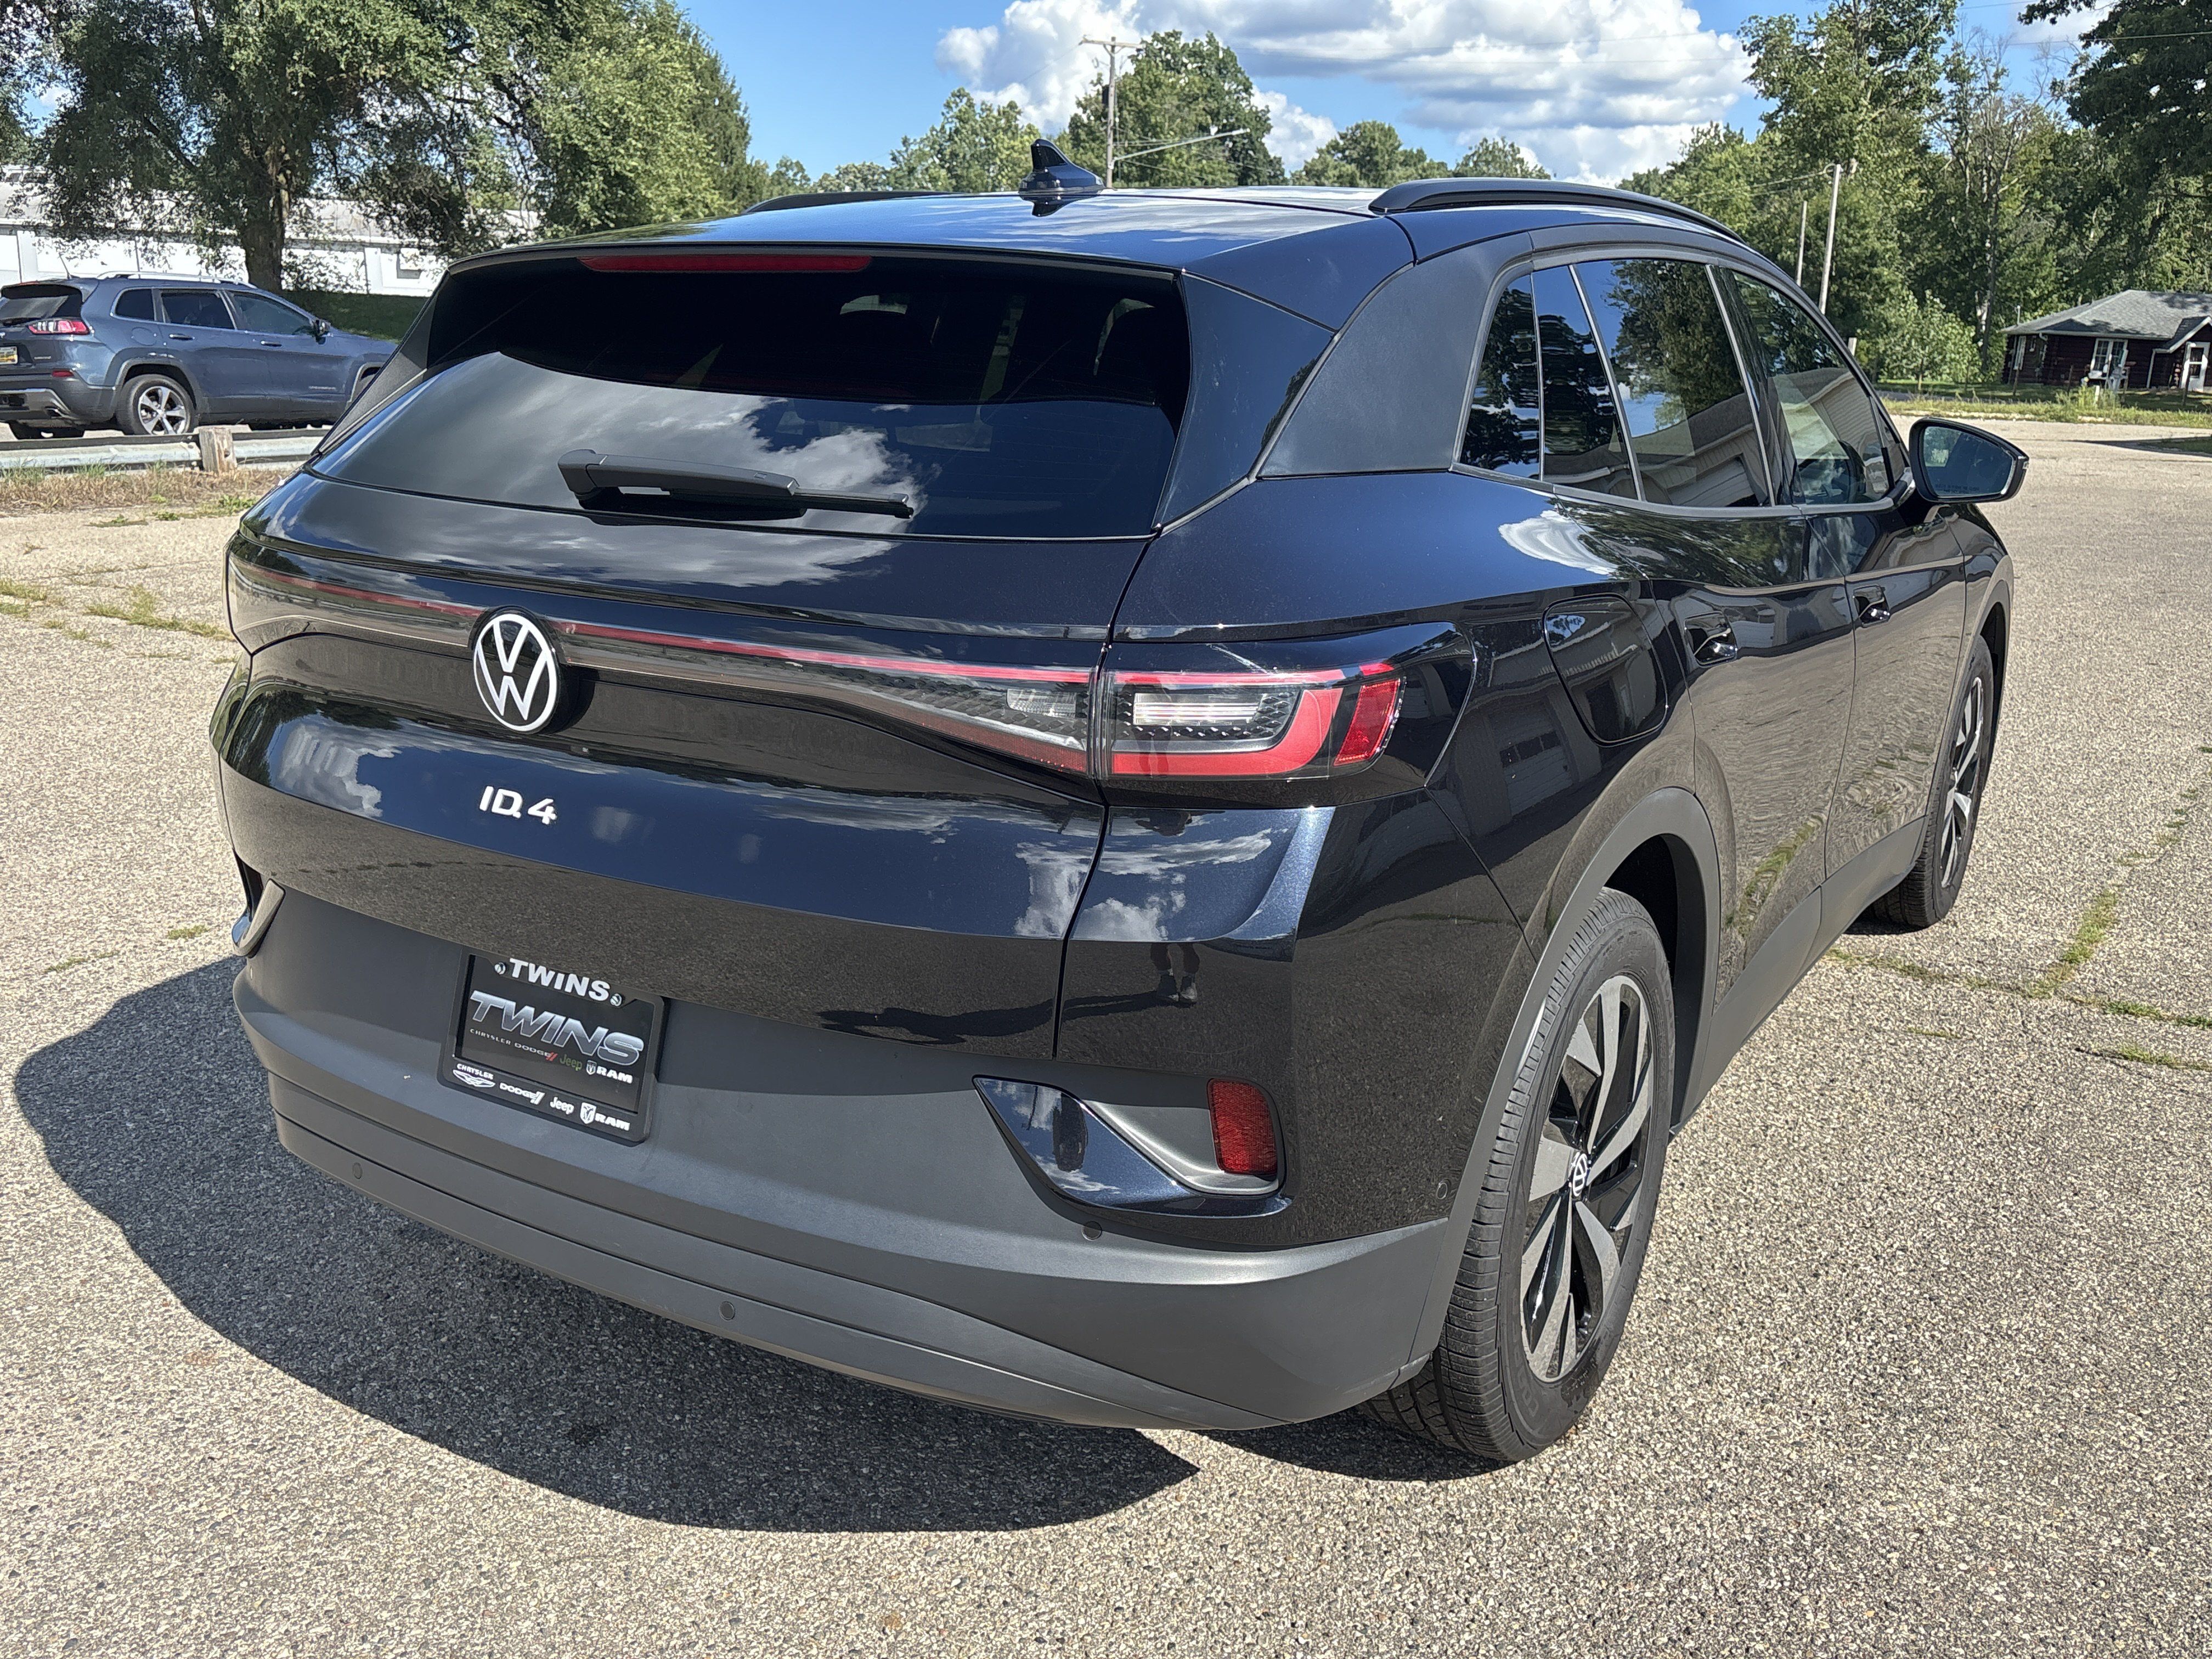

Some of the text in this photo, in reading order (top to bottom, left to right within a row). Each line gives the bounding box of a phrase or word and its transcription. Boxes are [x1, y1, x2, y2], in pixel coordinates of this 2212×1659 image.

[473, 613, 558, 732] VW
[509, 958, 611, 1002] TWINS
[470, 990, 644, 1066] TWINS
[470, 1029, 633, 1084] CHRYSLER DODGE Jeep RAM
[456, 1063, 630, 1131] CHRYSLER DODGE Jeep RAM
